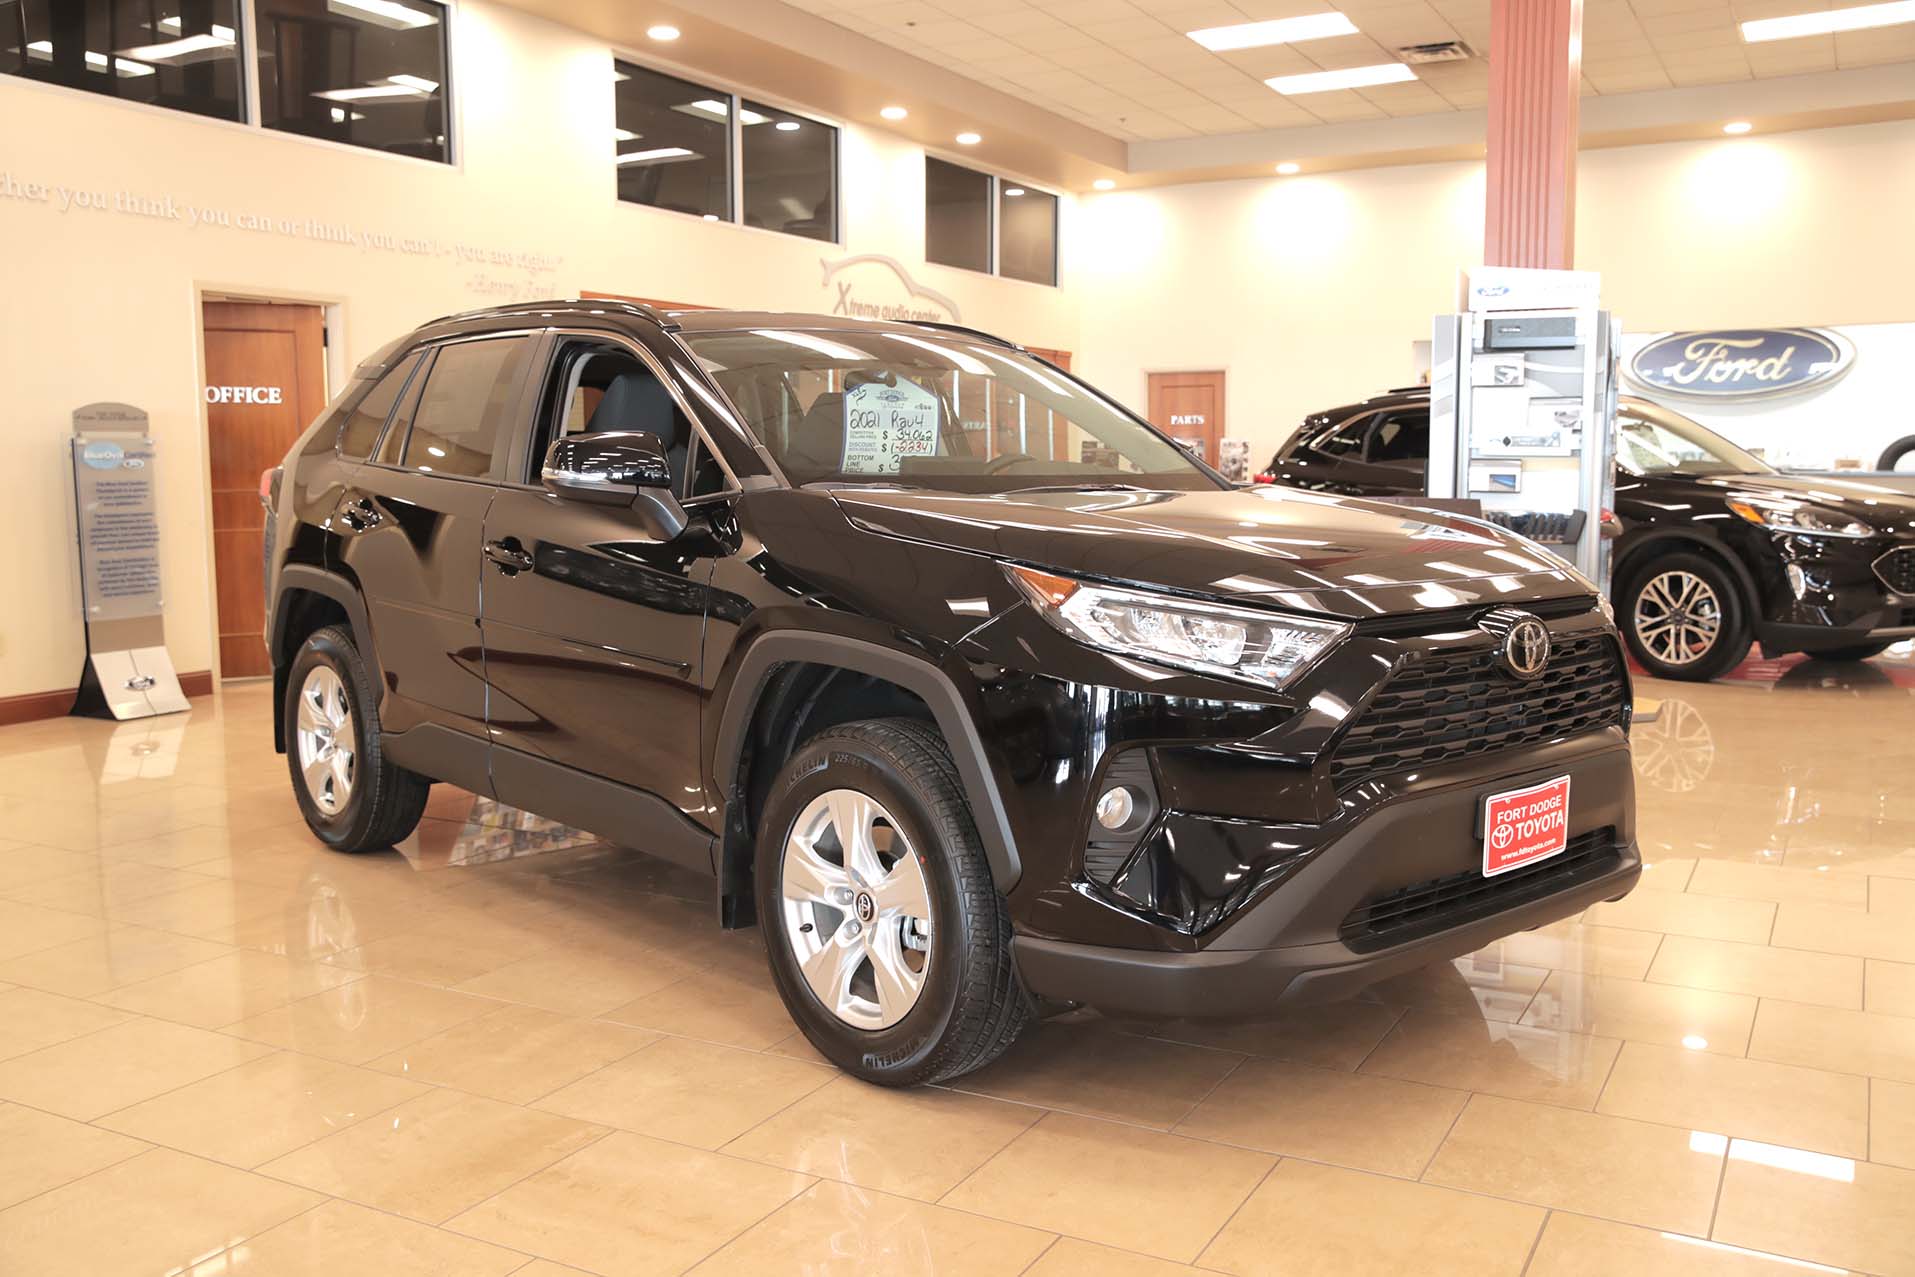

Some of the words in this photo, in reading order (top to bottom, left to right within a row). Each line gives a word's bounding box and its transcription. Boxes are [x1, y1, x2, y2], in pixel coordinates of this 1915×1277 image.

[56, 185, 108, 215] you
[113, 189, 181, 219] think
[187, 205, 231, 230] you
[236, 212, 273, 232] can
[279, 219, 298, 236] or
[304, 217, 356, 245] think
[361, 231, 396, 254] you
[833, 280, 881, 318] Xtreme
[881, 304, 909, 319] audio
[911, 308, 941, 321] center
[1670, 337, 1796, 384] Ford
[204, 385, 282, 404] OFFICE
[850, 409, 880, 429] 2021
[1170, 415, 1205, 425] PARTS
[881, 443, 887, 452] $
[883, 430, 888, 440] $
[1497, 806, 1528, 825] FORT
[1530, 794, 1562, 816] DODGE
[1516, 809, 1564, 840] TOYOTA
